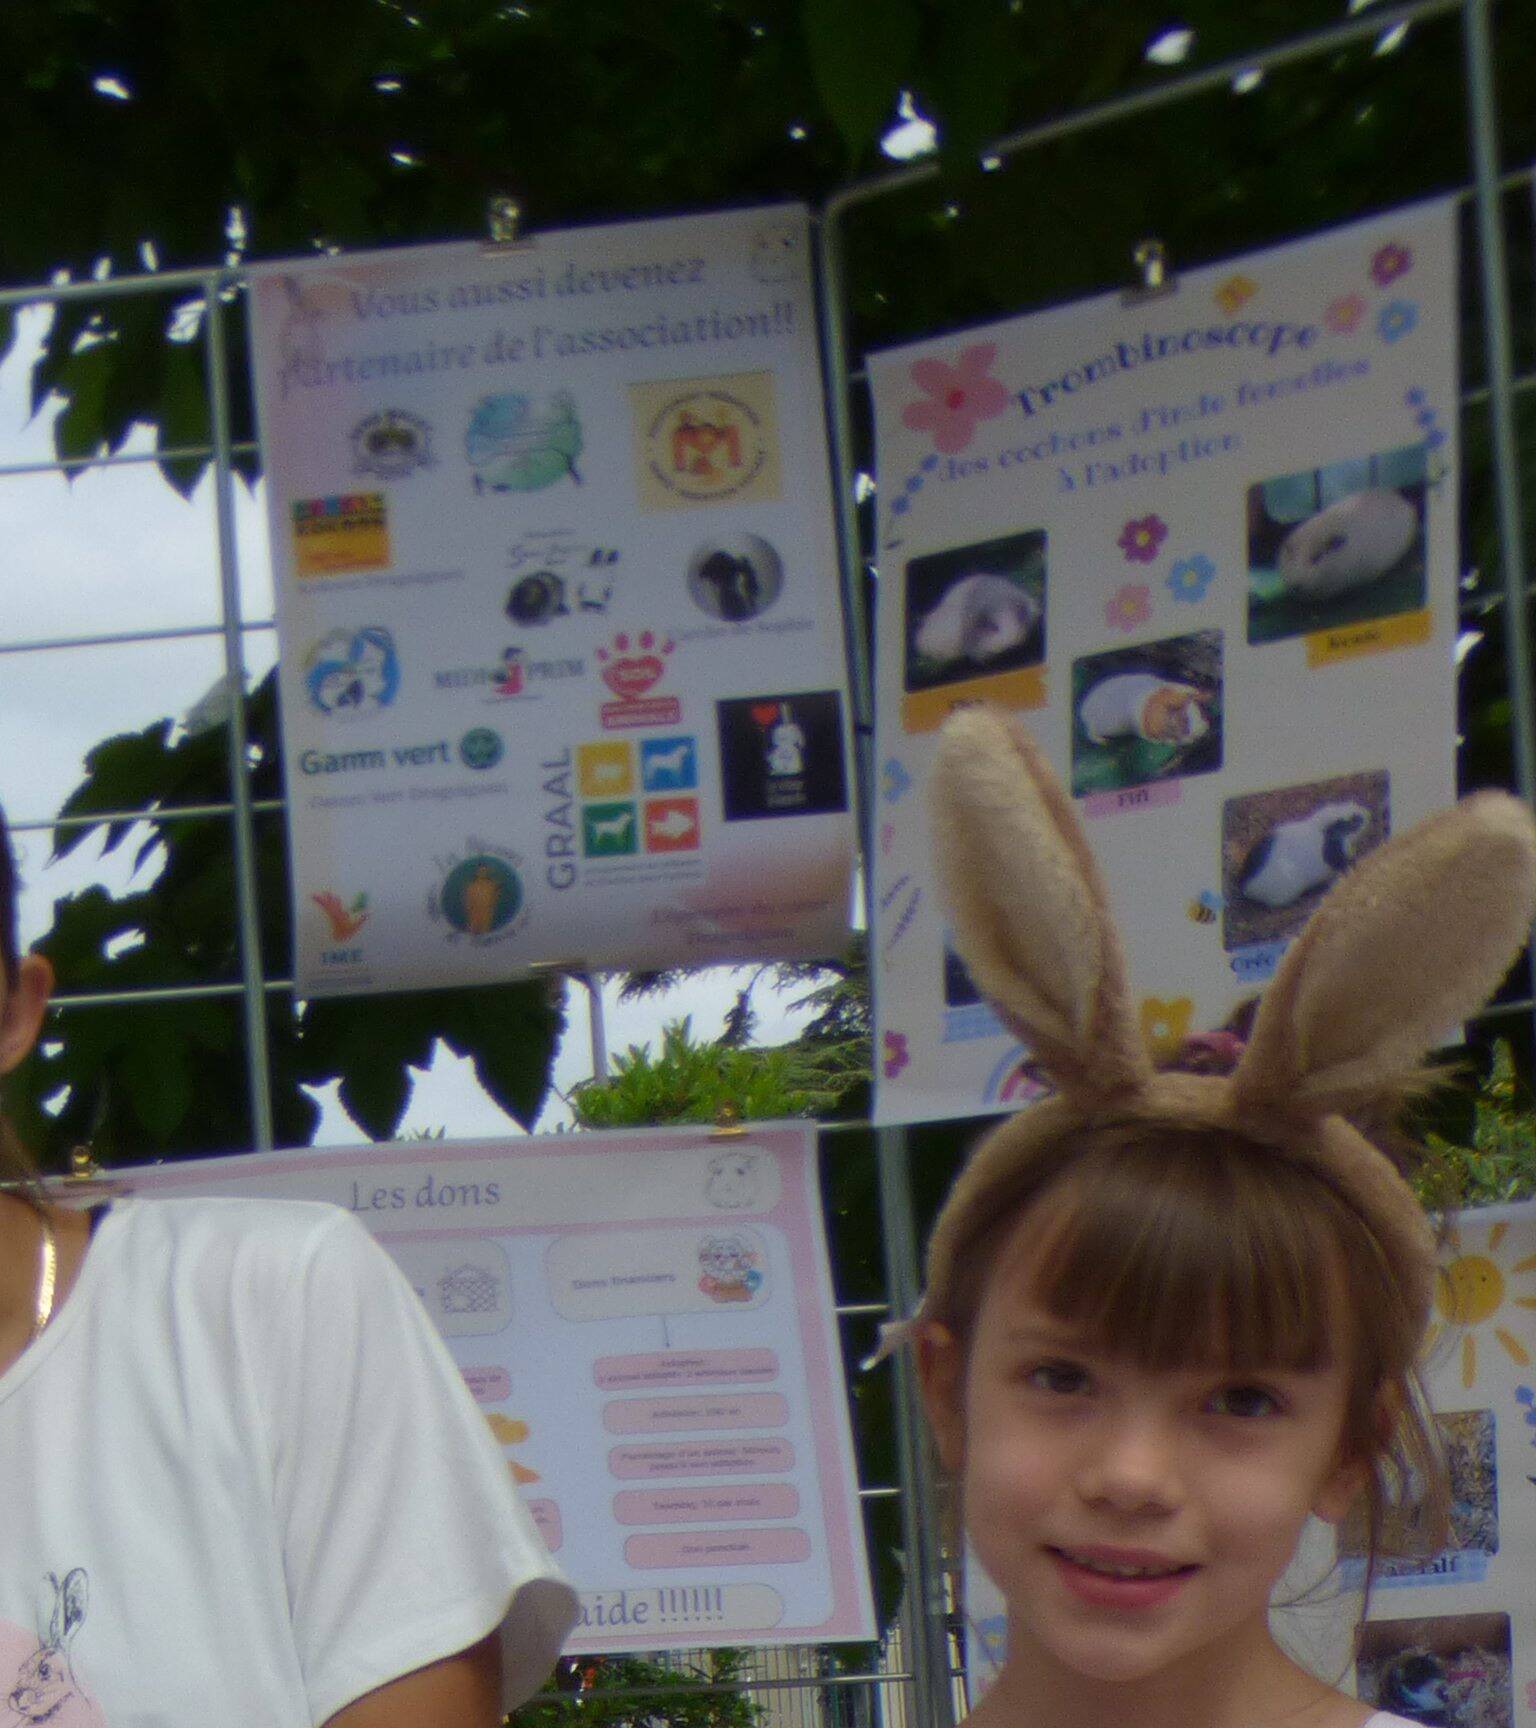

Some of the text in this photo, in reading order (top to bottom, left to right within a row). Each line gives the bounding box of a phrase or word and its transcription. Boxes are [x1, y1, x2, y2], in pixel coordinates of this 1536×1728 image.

[352, 257, 704, 321] Vous aussi devenez
[484, 328, 523, 367] de
[1011, 320, 1319, 418] Trombinoscope
[393, 741, 451, 767] vert
[542, 747, 577, 890] GRAAL
[350, 1176, 502, 1212] Les dons
